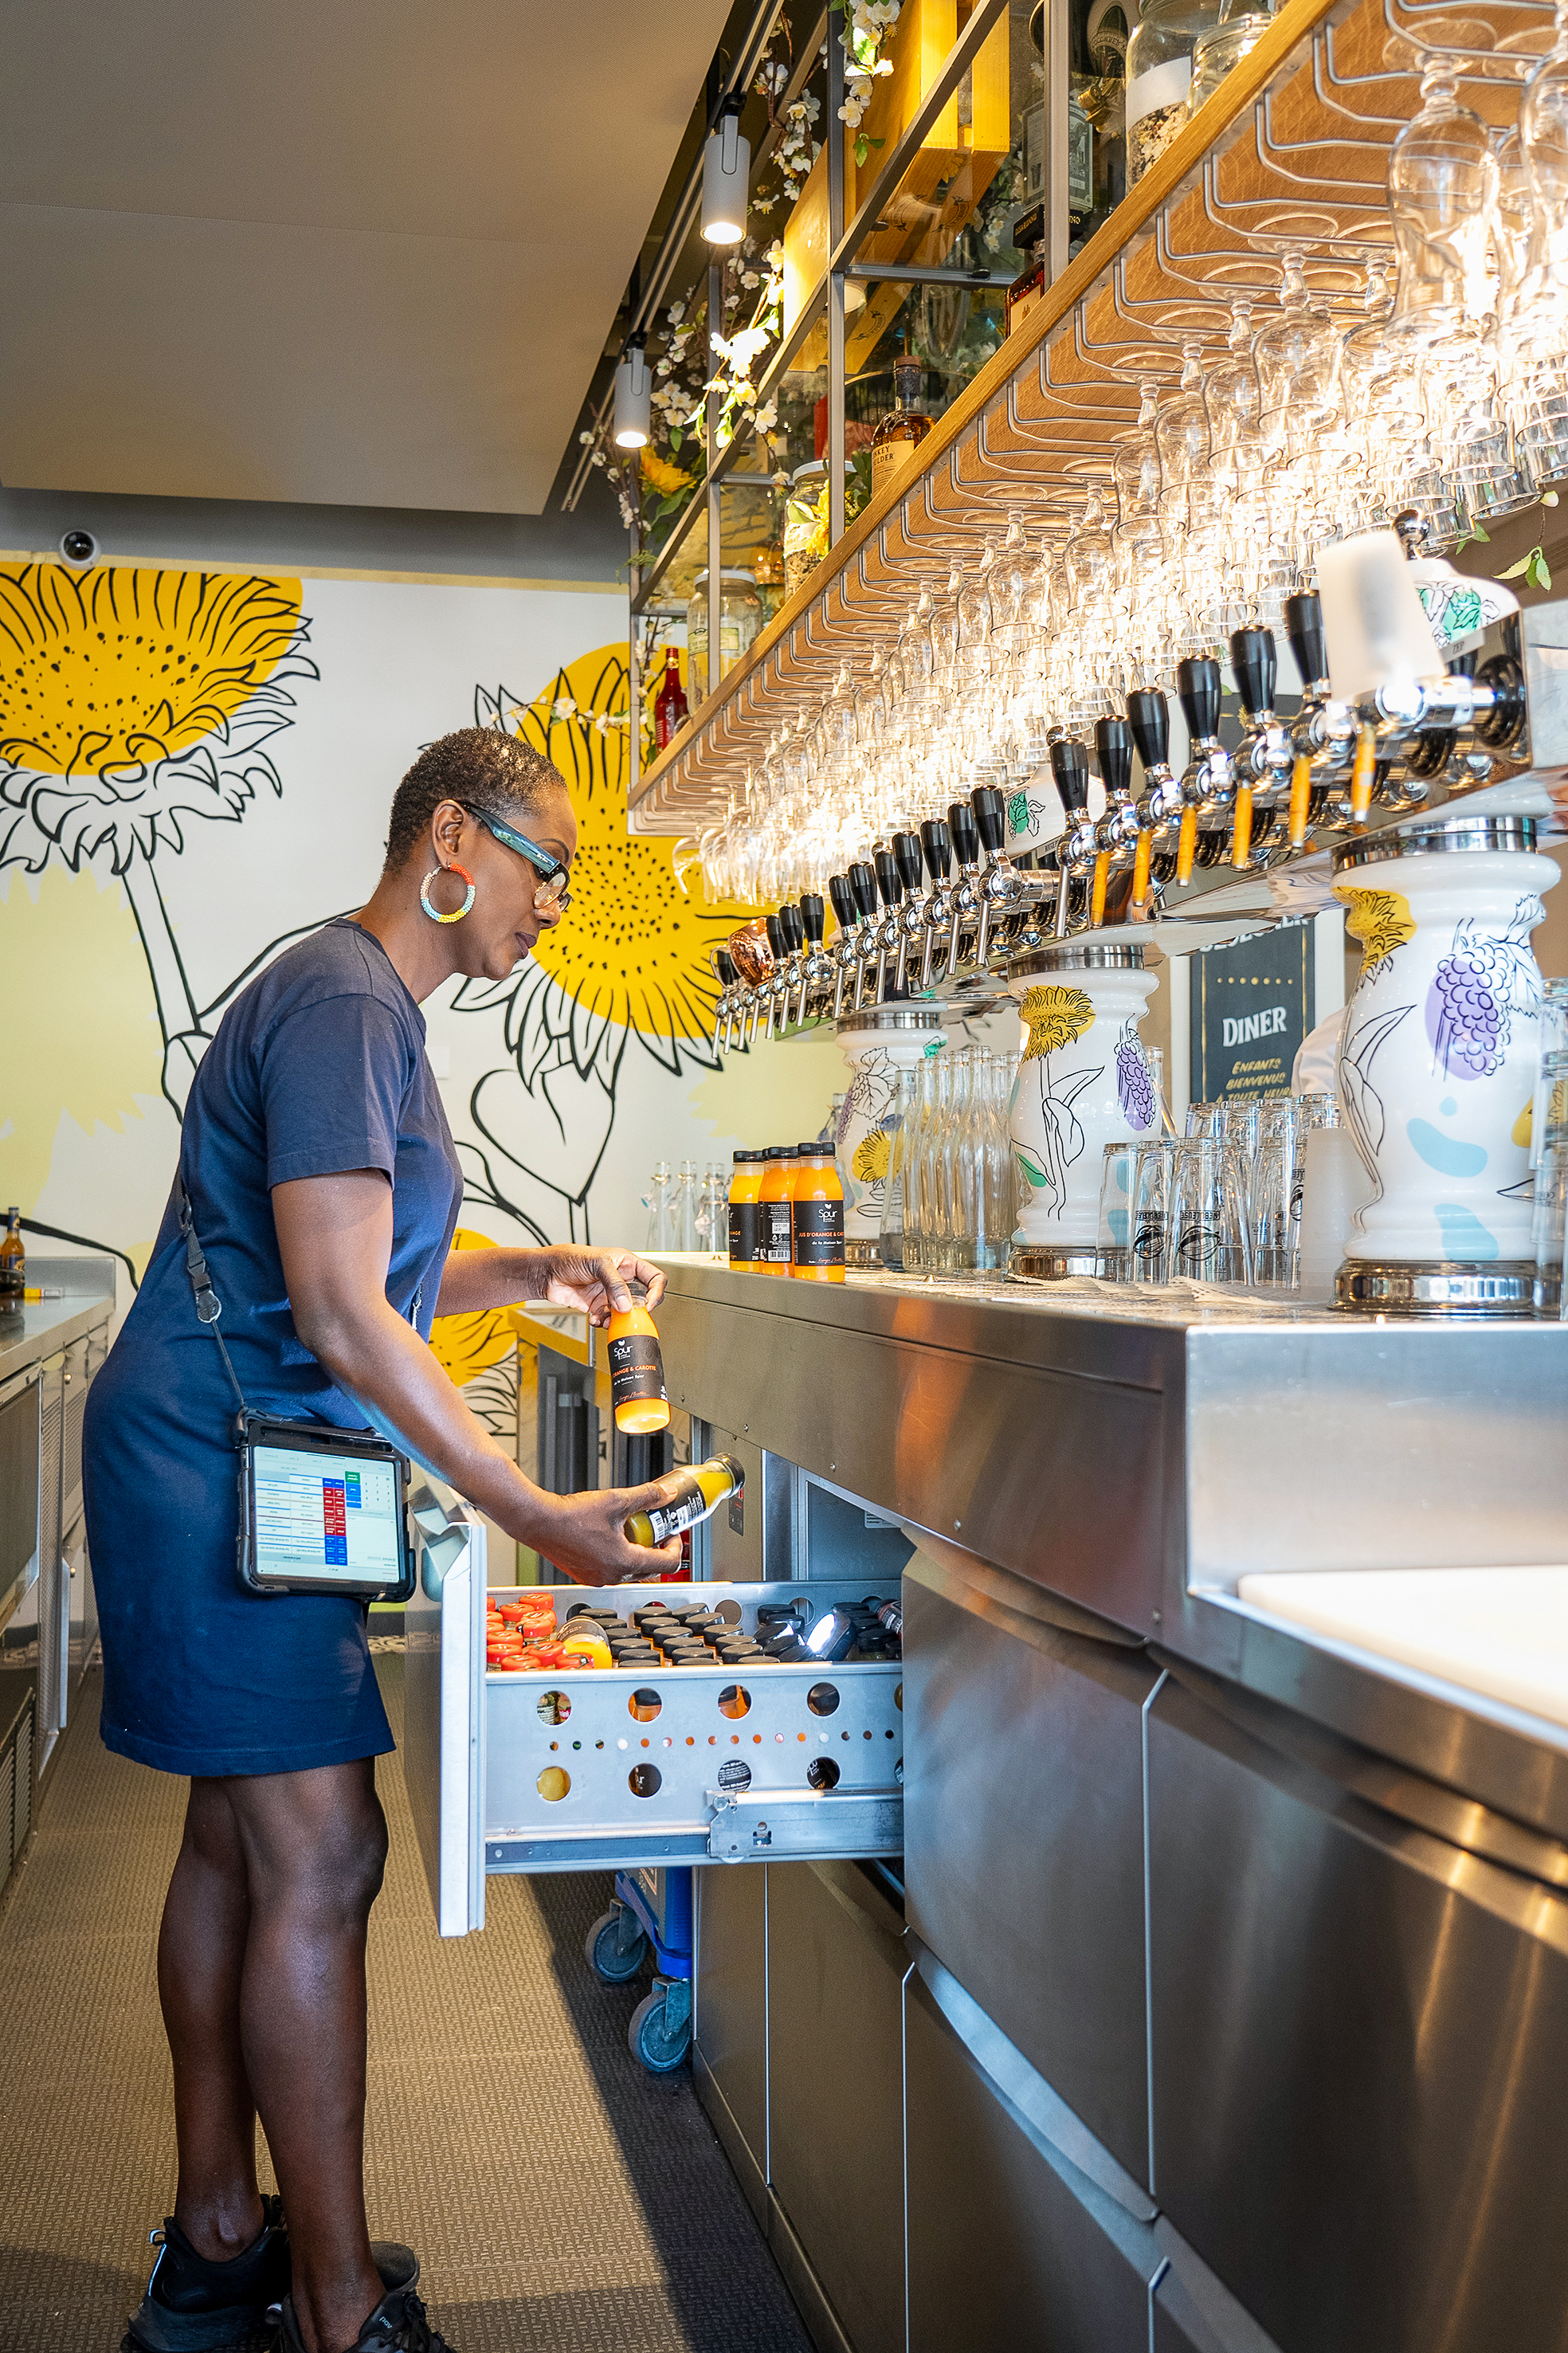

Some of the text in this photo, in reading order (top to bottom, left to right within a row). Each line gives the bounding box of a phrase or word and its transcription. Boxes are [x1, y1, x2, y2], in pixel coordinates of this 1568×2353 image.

[1222, 1006, 1287, 1047] DINER
[1232, 1057, 1282, 1075] ENFANTS
[1225, 1072, 1286, 1090] BIENVENUS
[1263, 1086, 1292, 1099] HEUR
[817, 1209, 838, 1222] Spur
[613, 1345, 633, 1360] Spur
